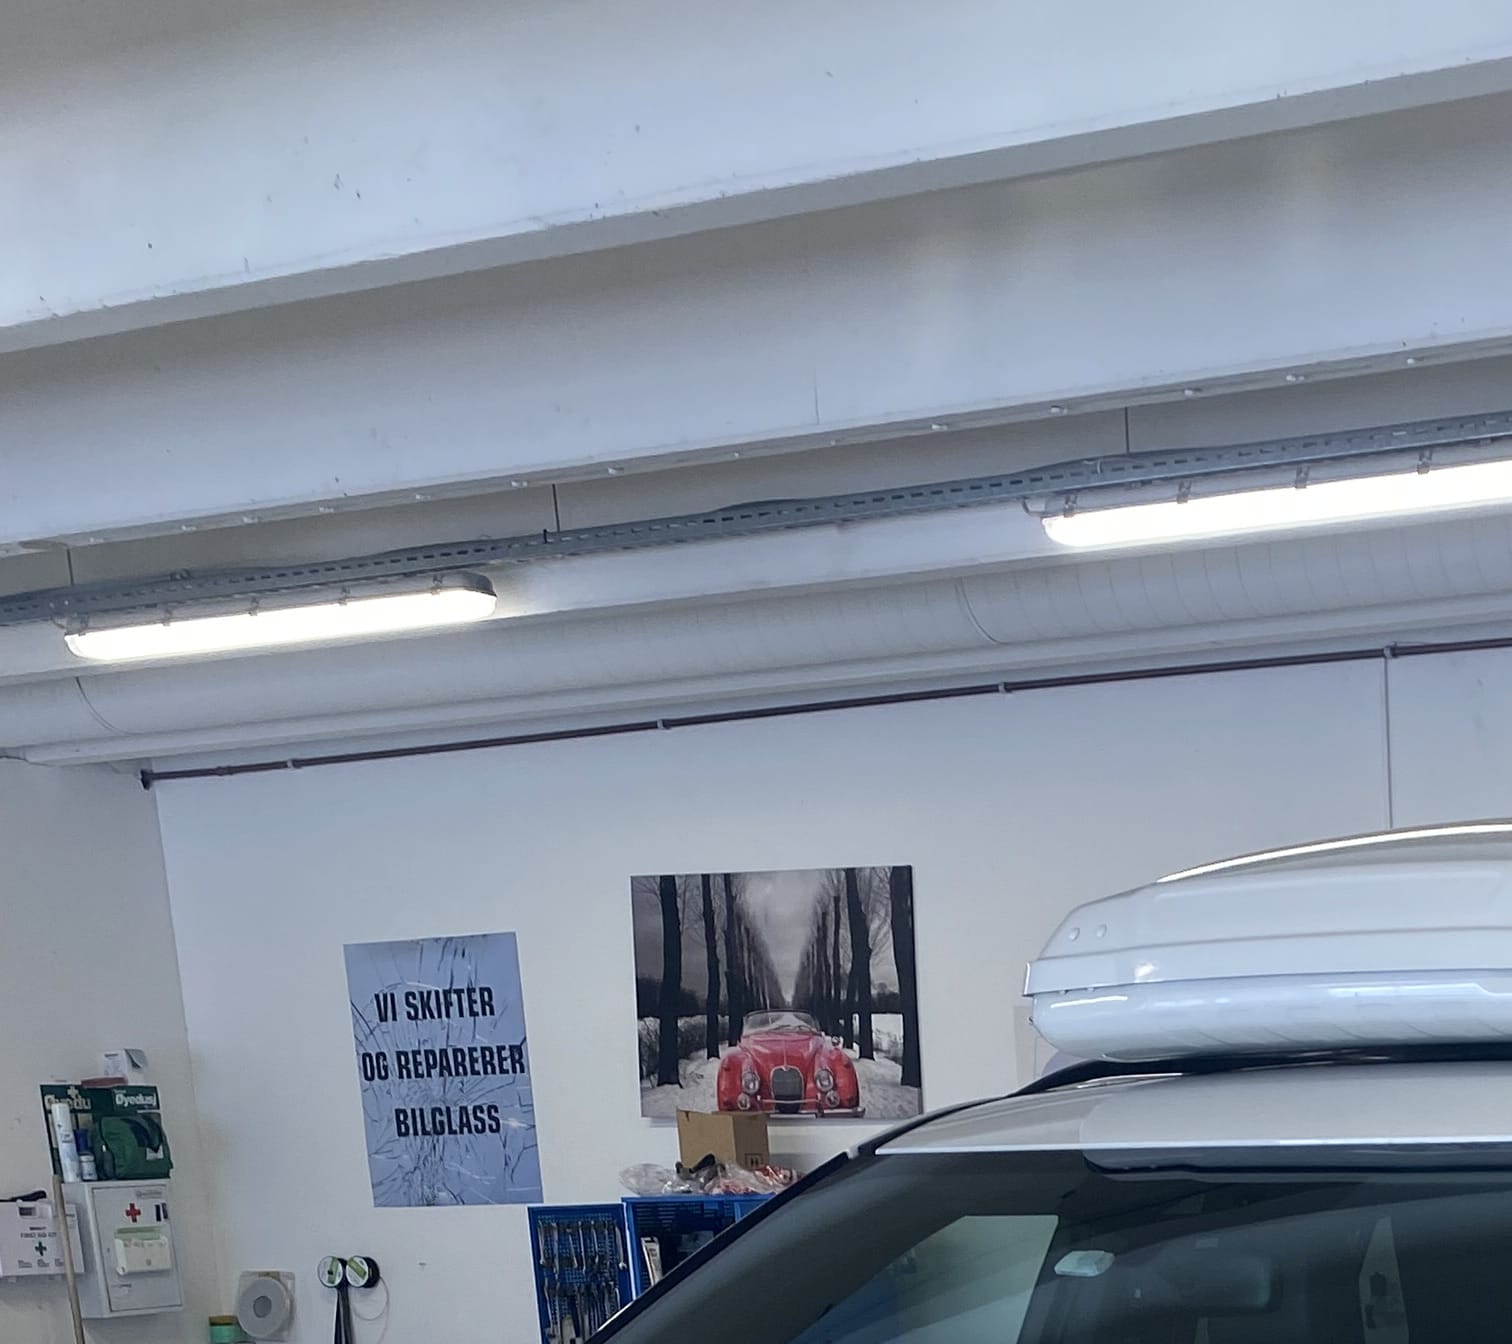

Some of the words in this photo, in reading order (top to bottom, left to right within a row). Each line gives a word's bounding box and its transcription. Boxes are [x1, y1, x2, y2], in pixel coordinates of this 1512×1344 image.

[374, 993, 397, 1022] VI
[404, 987, 495, 1020] SKIFTER
[362, 1052, 389, 1081] OG
[396, 1044, 525, 1080] REPARERER
[394, 1104, 501, 1137] BILGLASS
